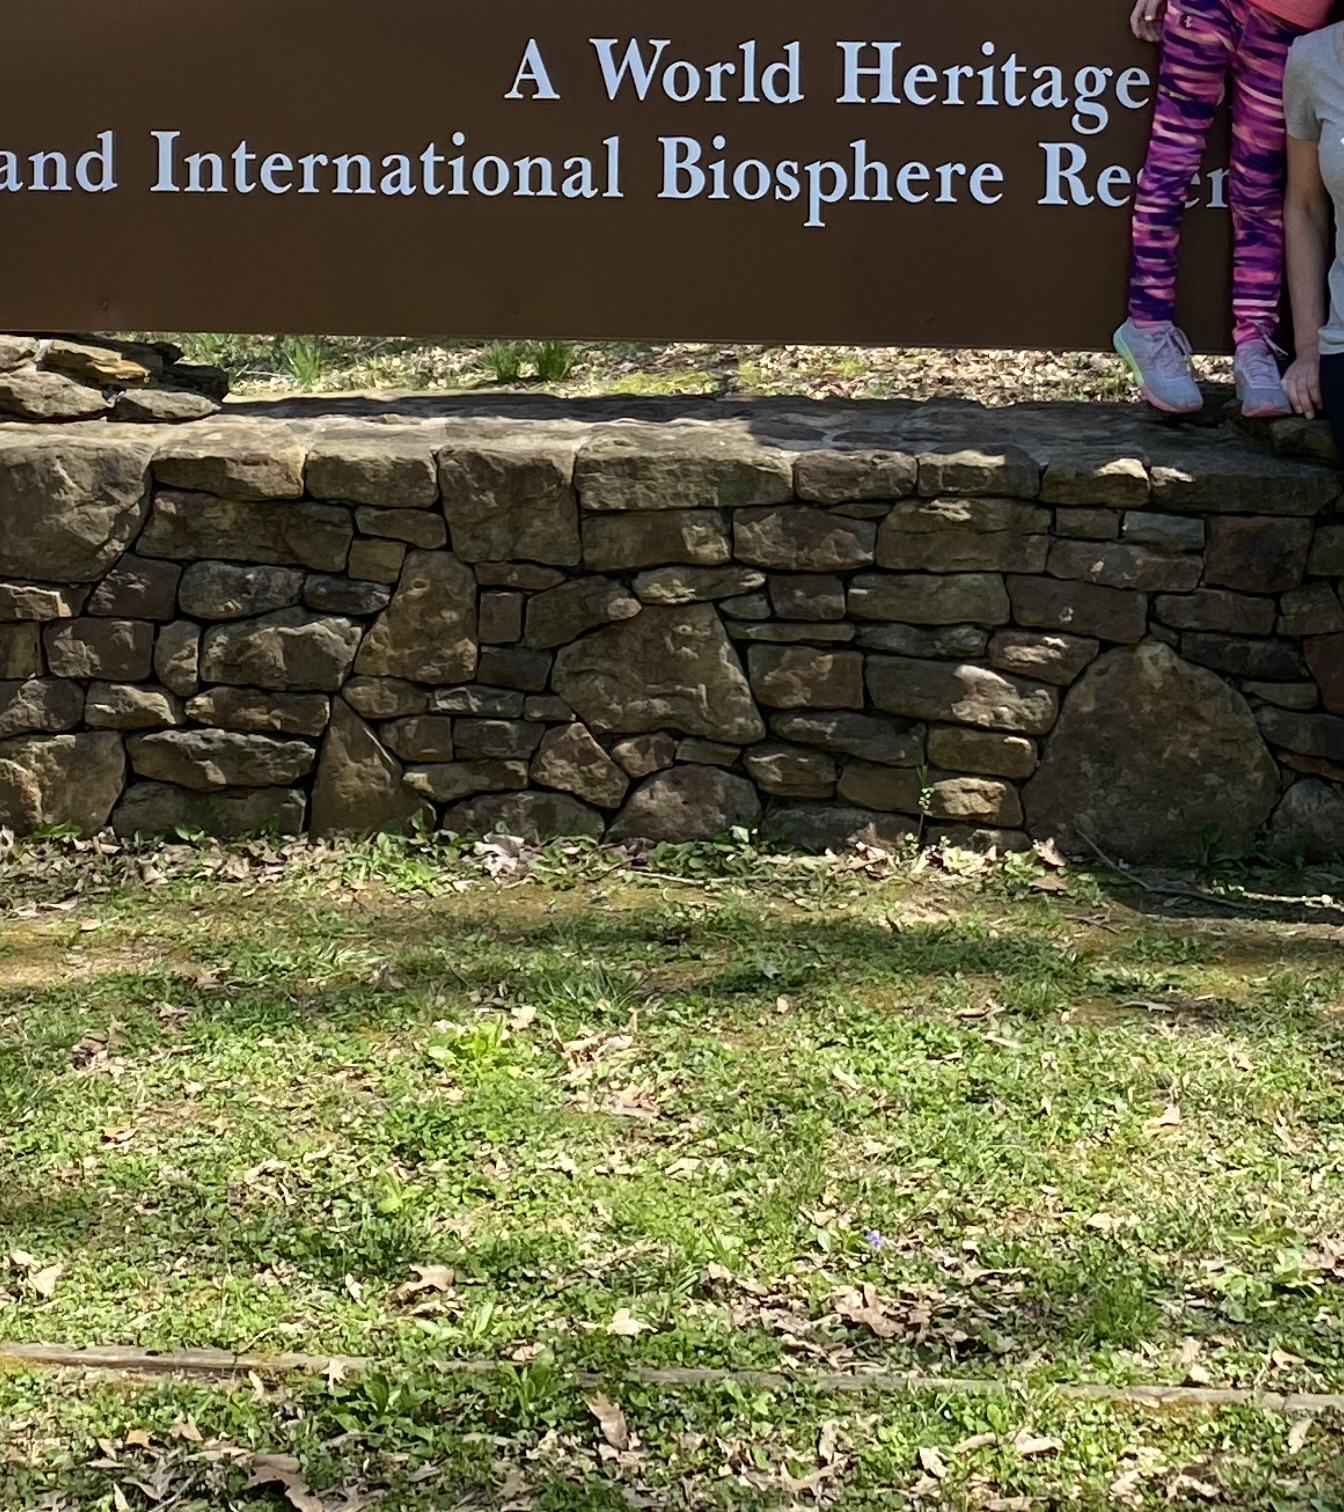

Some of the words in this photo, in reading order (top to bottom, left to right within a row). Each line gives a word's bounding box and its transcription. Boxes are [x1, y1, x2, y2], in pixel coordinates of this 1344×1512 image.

[504, 38, 561, 99] A
[589, 37, 805, 104] World
[835, 41, 1150, 135] Heritage
[150, 130, 624, 199] International
[657, 135, 1004, 228] Biosphere
